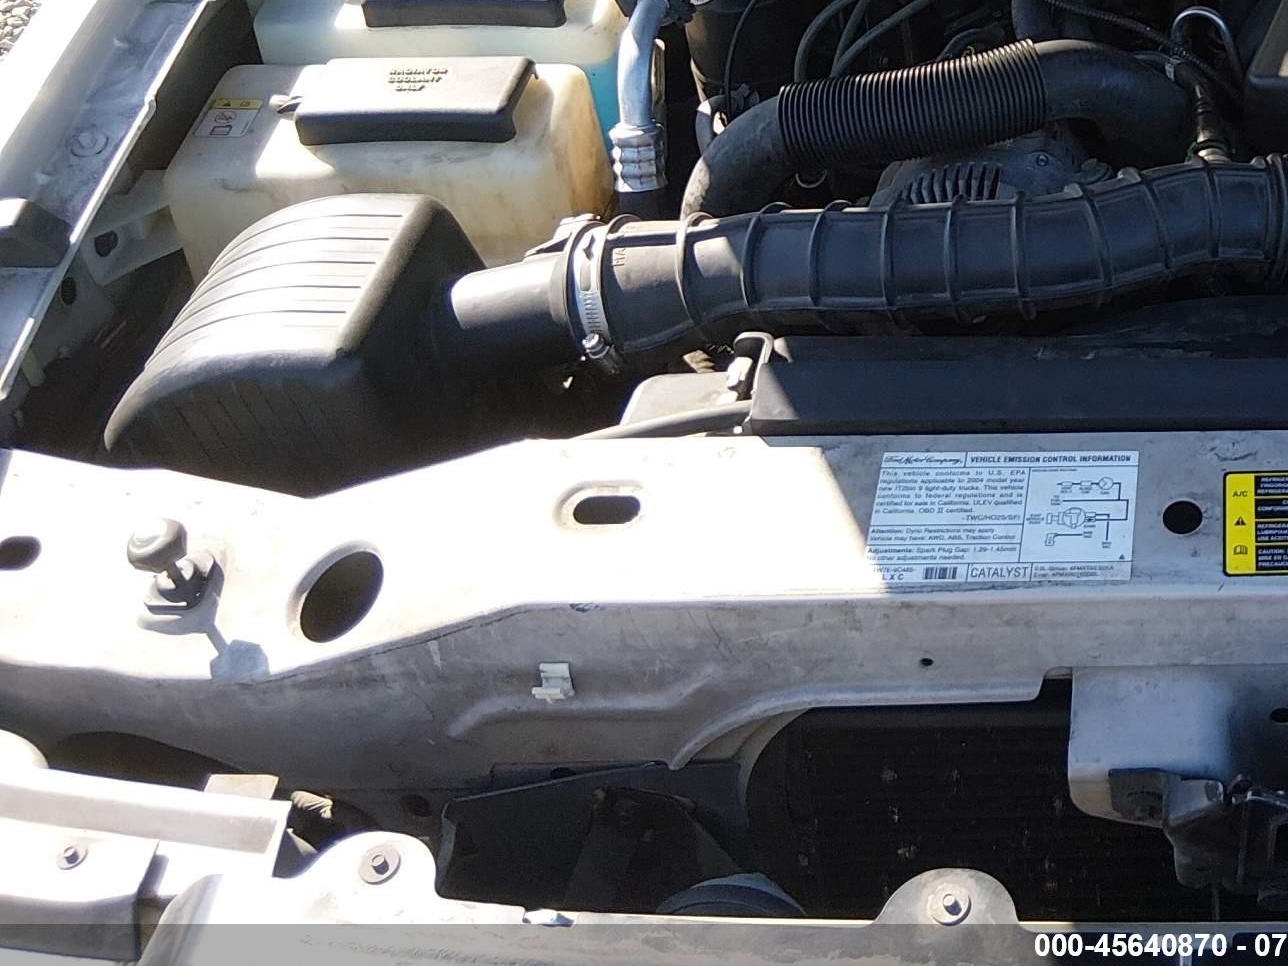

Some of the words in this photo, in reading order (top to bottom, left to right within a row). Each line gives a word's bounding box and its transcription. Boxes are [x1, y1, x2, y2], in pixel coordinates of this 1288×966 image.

[970, 455, 1000, 464] VEHICLE
[1004, 455, 1040, 463] EMISSION
[1042, 455, 1077, 463] CONTROL
[1080, 454, 1131, 462] INFORMATION
[967, 477, 984, 485] 2004
[1231, 489, 1248, 497] A/C
[970, 566, 1030, 579] CATALYST
